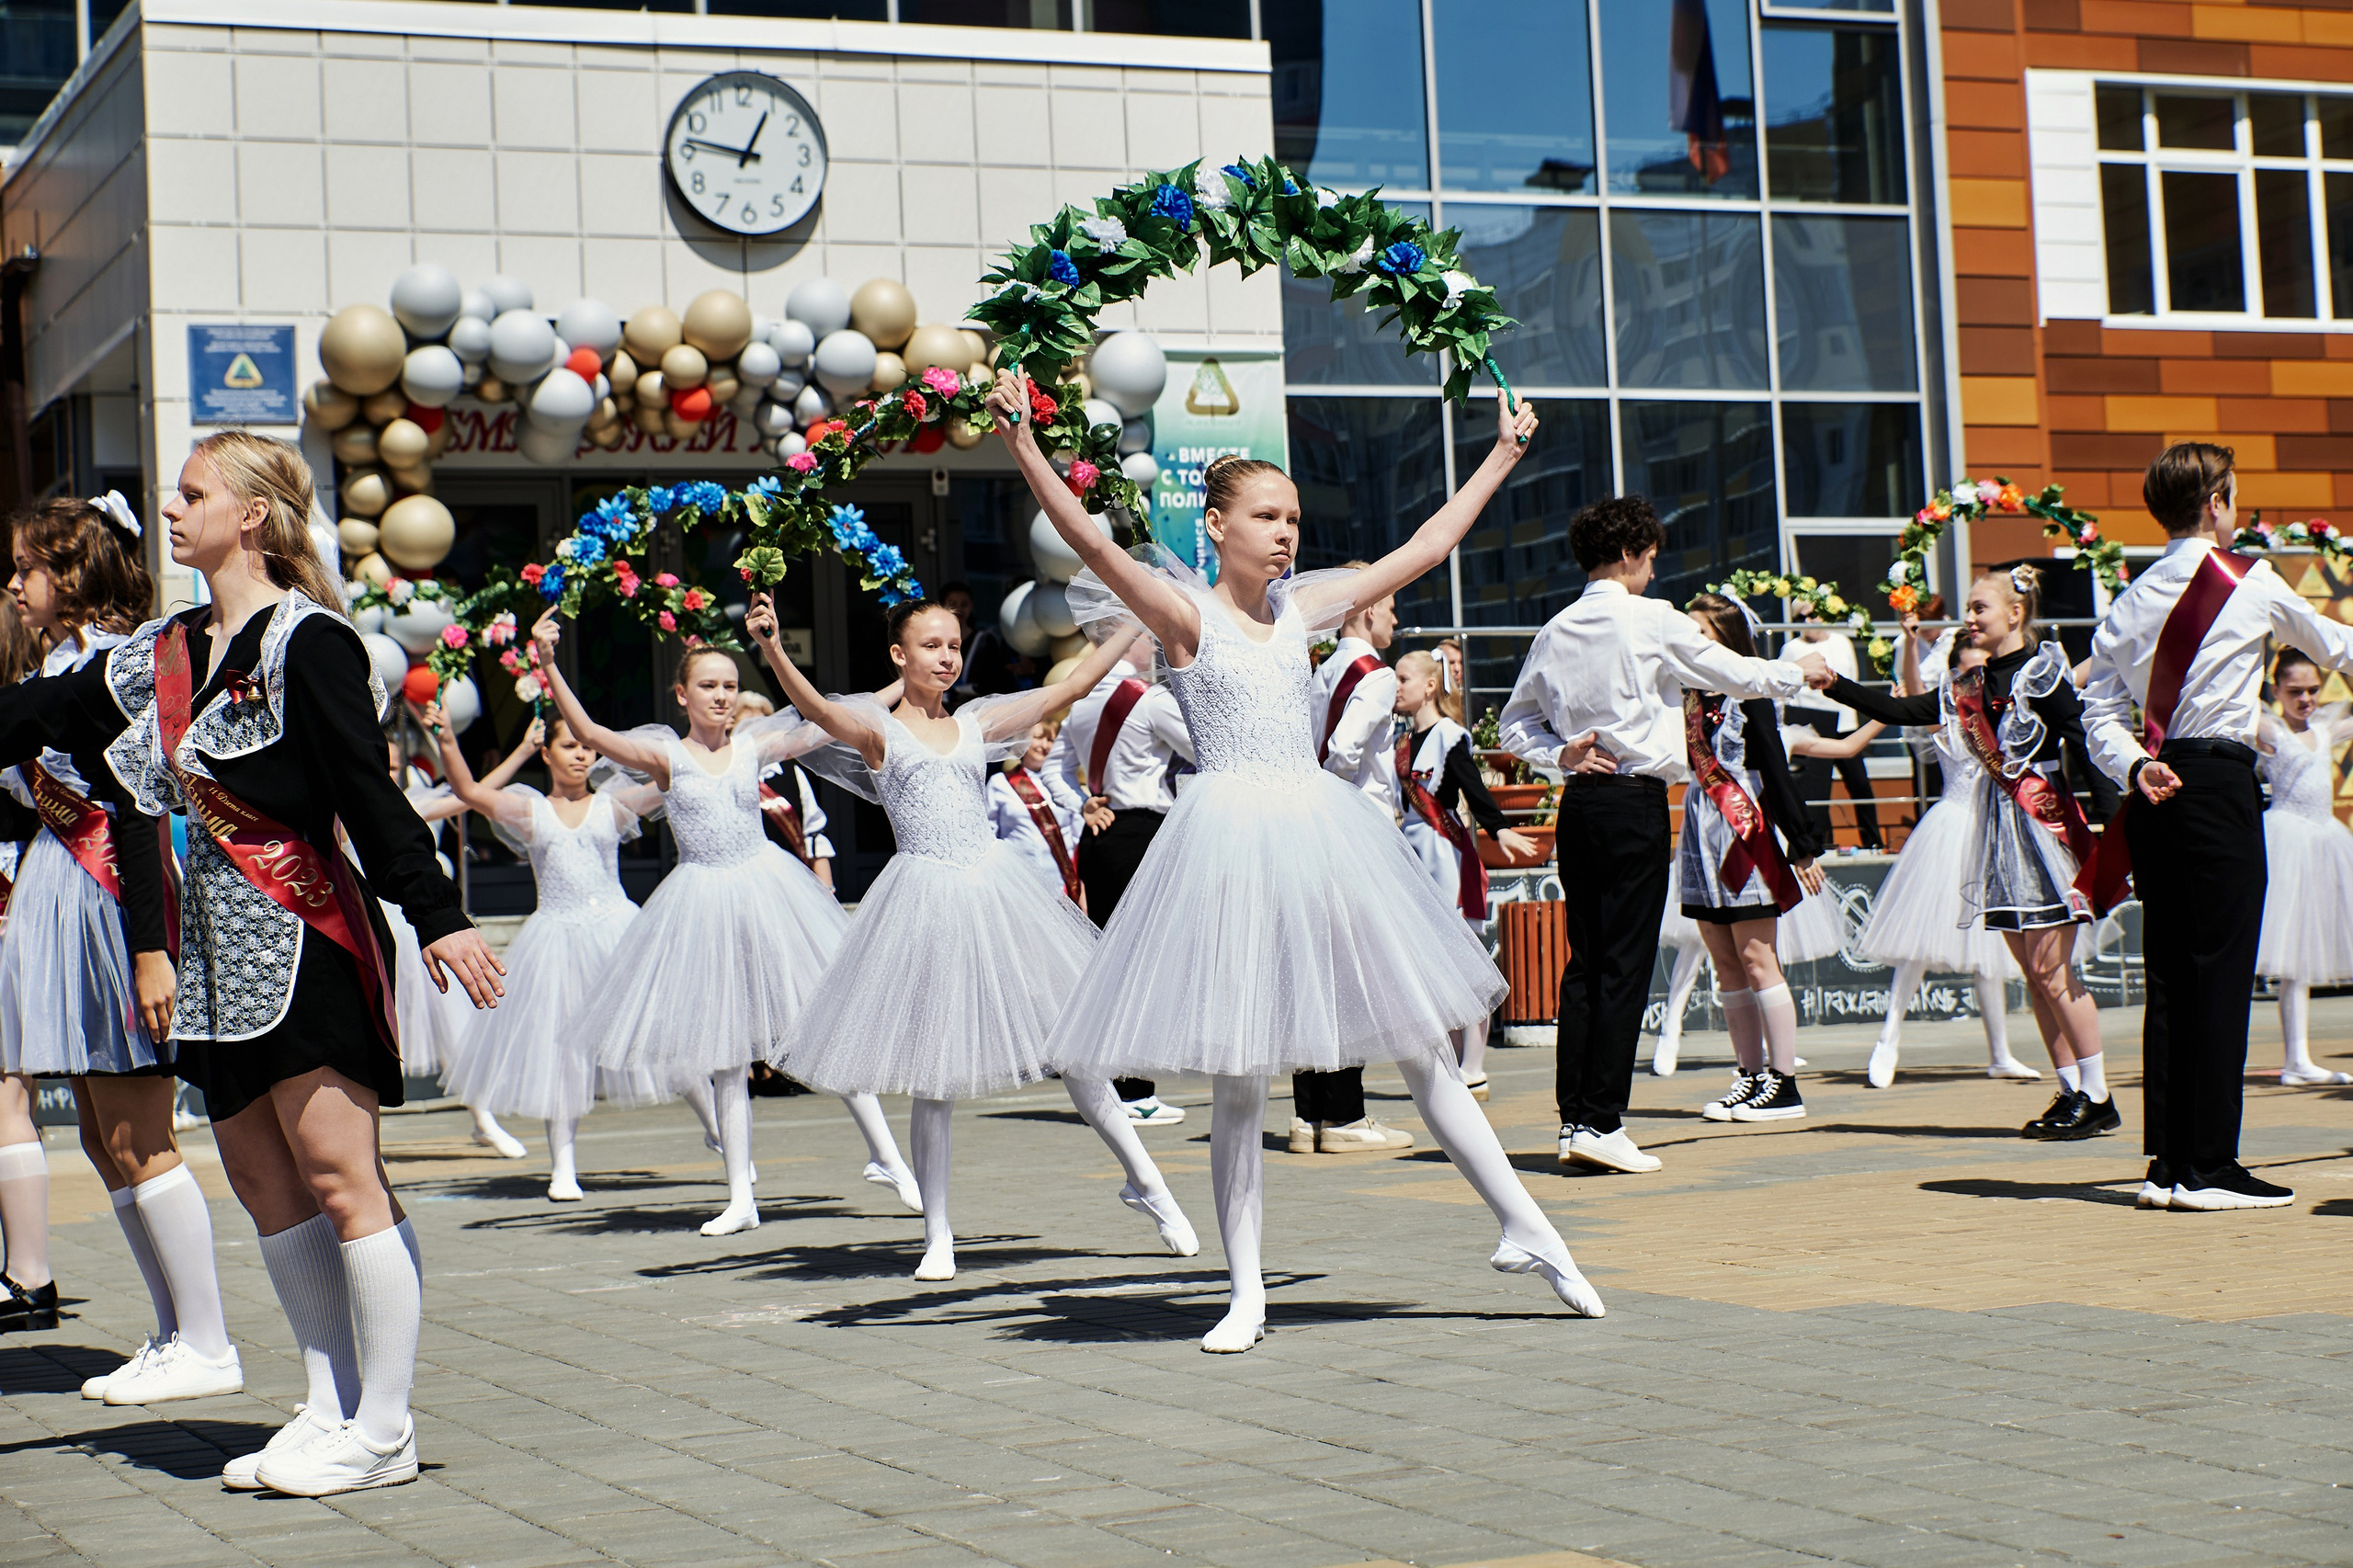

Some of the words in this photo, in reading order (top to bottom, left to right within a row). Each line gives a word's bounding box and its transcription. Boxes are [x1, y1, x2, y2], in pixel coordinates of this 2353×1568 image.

[710, 90, 722, 113] 11
[735, 83, 753, 108] 12
[785, 114, 800, 137] 2
[679, 142, 696, 164] 9
[798, 143, 811, 167] 3
[691, 171, 705, 195] 8
[790, 175, 803, 193] 4
[716, 193, 731, 215] 7
[741, 202, 757, 224] 6
[770, 194, 784, 218] 5
[1161, 470, 1172, 485] С
[1177, 470, 1207, 485] ТО
[247, 840, 335, 907] 2023
